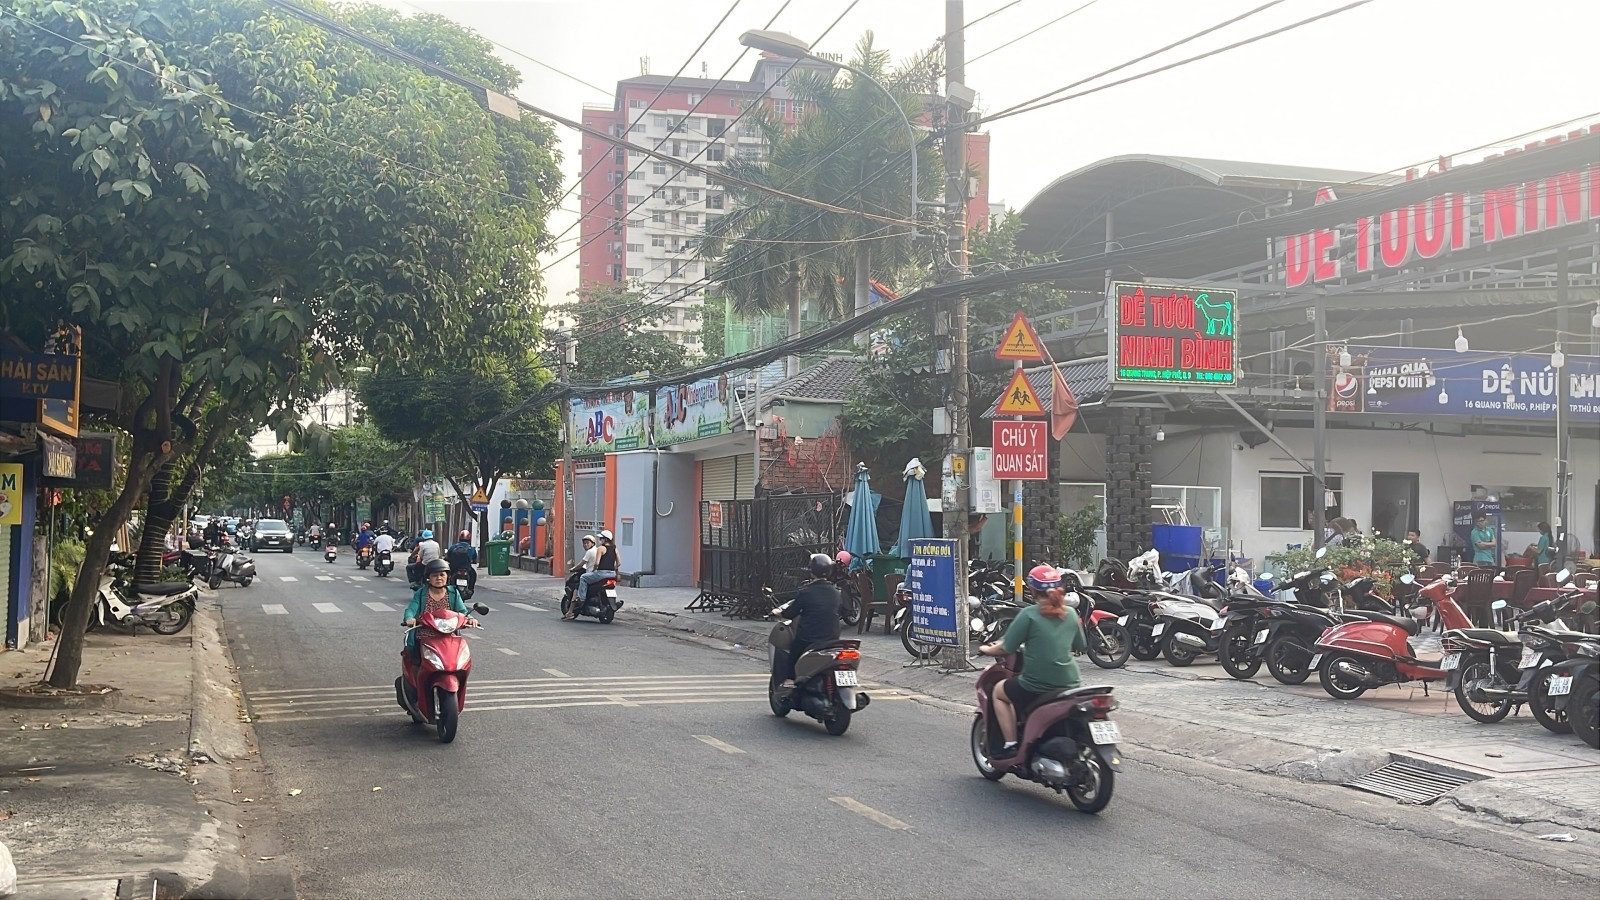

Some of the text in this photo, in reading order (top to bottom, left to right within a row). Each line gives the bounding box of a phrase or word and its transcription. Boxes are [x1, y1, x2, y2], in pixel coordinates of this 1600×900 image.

[1120, 288, 1195, 329] DÊ TƯƠI
[1120, 331, 1232, 370] NINH BÌNH
[2, 359, 72, 381] HẢI SẢN
[1369, 376, 1396, 388] PEPSI
[22, 383, 49, 394] KTV
[1465, 400, 1473, 409] 16
[1475, 401, 1501, 410] QUANG
[1502, 401, 1528, 412] TRUNG,
[586, 410, 615, 446] ABC
[1001, 423, 1038, 447] CHÚ Ý
[995, 453, 1023, 473] QUAN
[1025, 449, 1044, 473] SÁT
